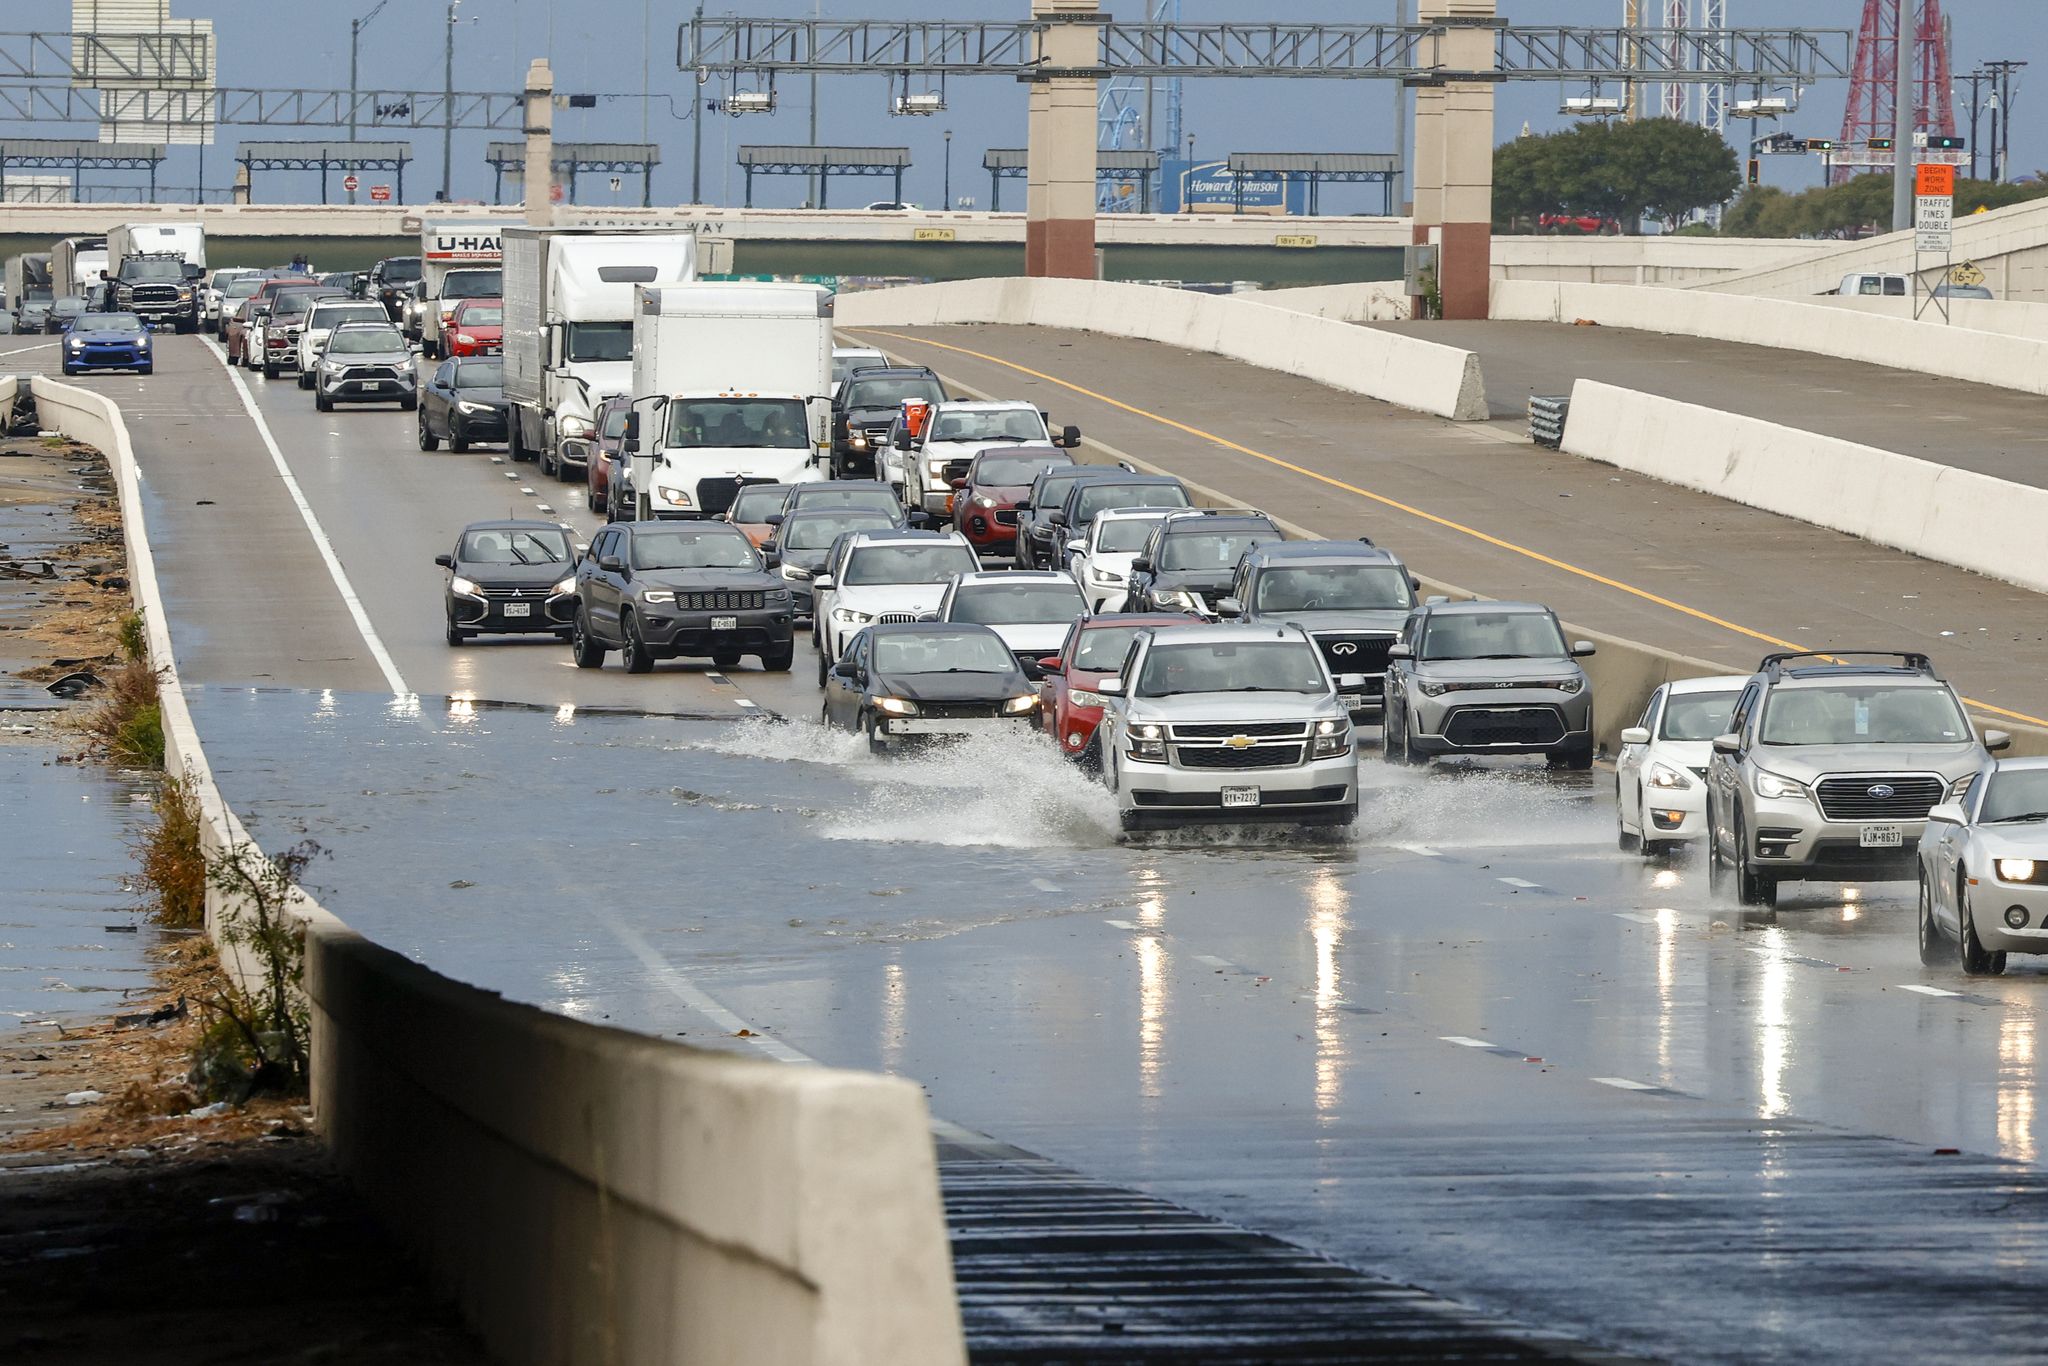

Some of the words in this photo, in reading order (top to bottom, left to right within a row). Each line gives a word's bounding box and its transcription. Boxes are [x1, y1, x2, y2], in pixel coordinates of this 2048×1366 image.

[1187, 180, 1232, 193] Howard
[1231, 180, 1278, 195] Johnson
[1919, 199, 1950, 207] TRAFFIC
[1923, 210, 1944, 218] FINES
[687, 222, 724, 233] WAY
[1919, 221, 1948, 229] DOUBLE
[1954, 271, 1980, 282] 16-7
